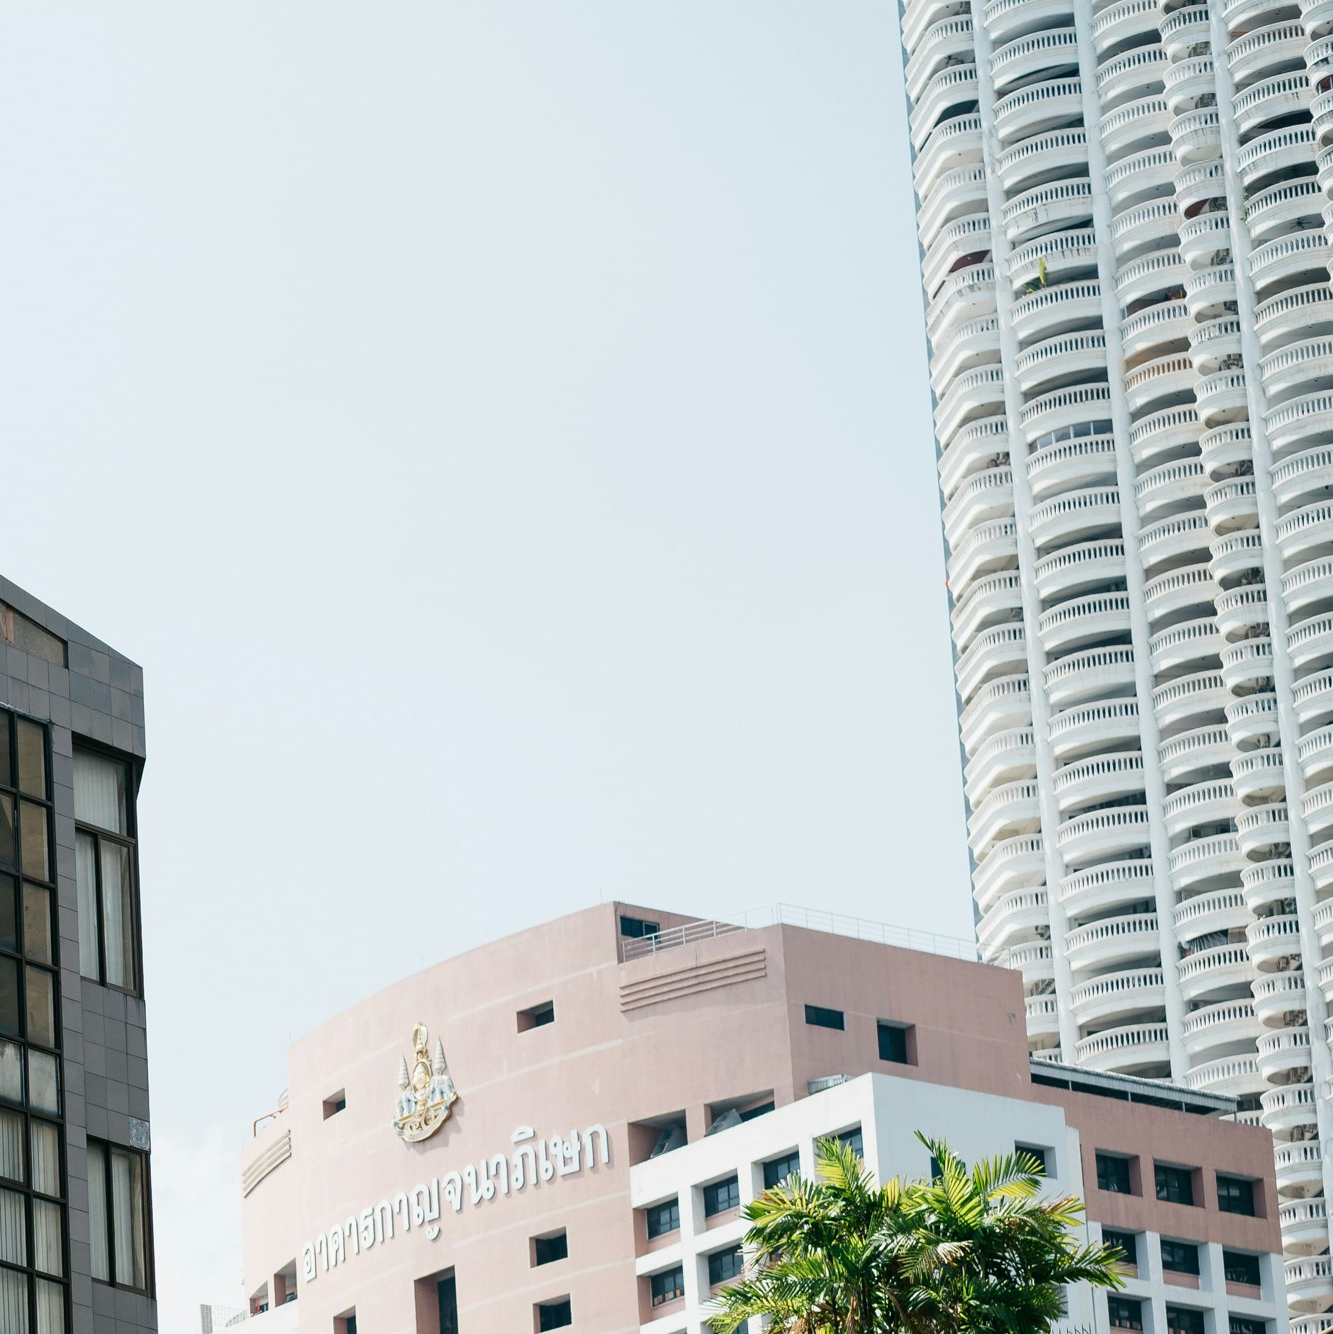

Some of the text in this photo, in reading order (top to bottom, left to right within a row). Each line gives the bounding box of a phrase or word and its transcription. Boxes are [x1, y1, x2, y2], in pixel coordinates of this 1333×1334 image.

[300, 1122, 611, 1284] อาคารกาญจนาภิเษก
